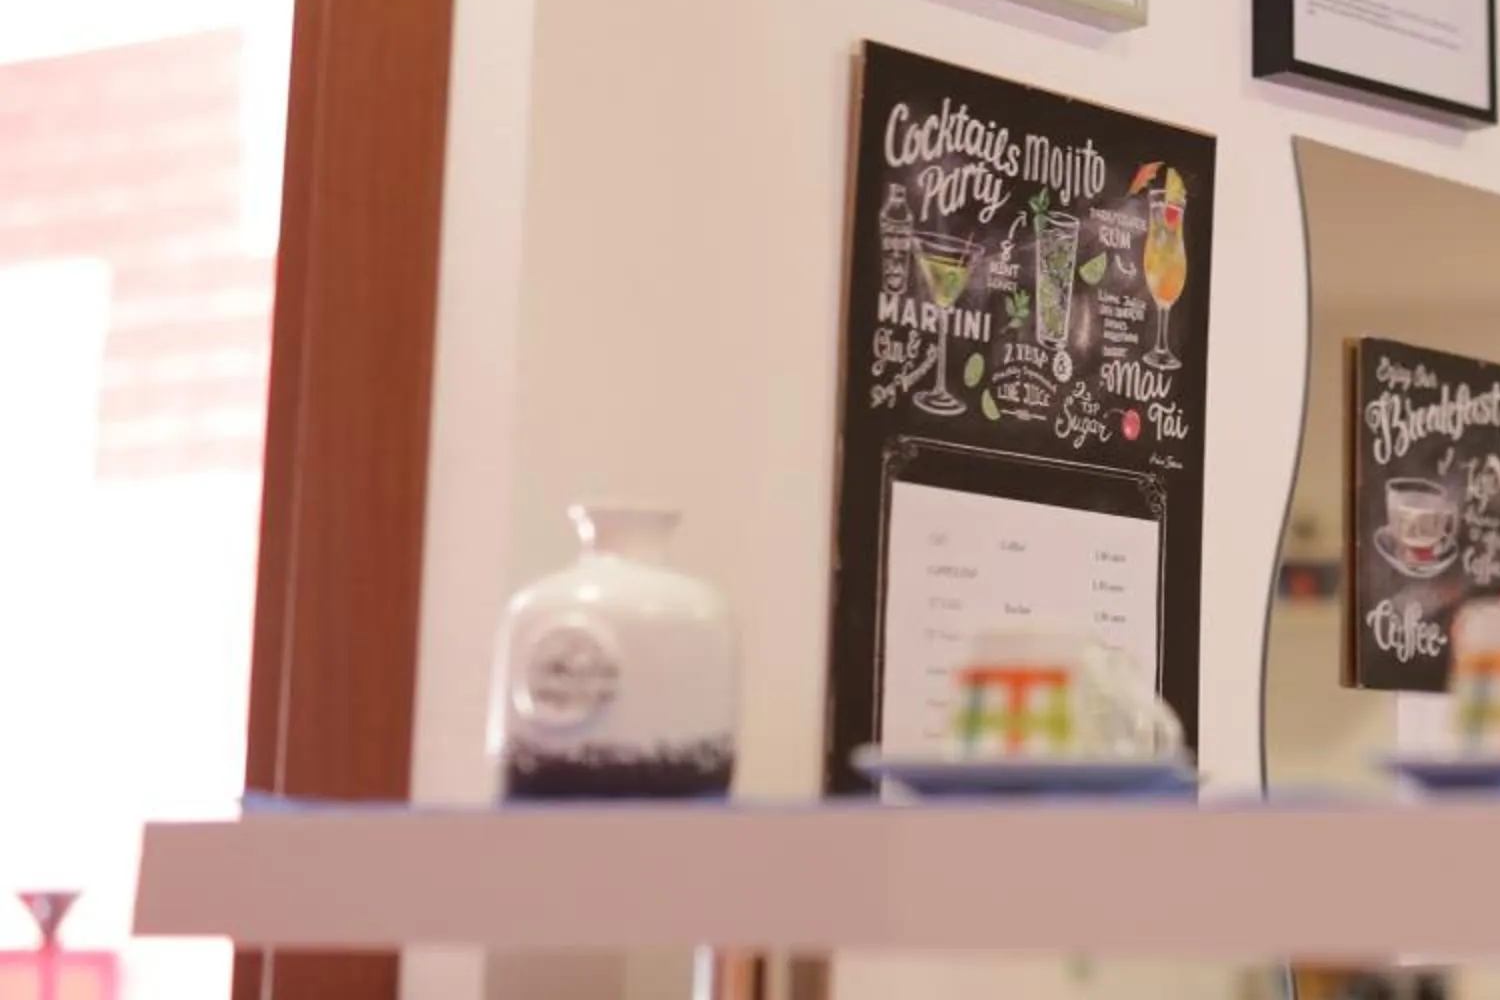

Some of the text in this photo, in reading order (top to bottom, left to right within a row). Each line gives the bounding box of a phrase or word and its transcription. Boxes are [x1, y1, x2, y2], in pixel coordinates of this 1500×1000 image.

[884, 97, 1021, 177] Cocktails
[917, 161, 1012, 223] Party
[877, 292, 992, 343] MARTINI
[1101, 361, 1172, 401] Mai
[1054, 395, 1112, 449] Sugar
[1148, 403, 1189, 441] Tai
[1366, 599, 1448, 663] Coffee
